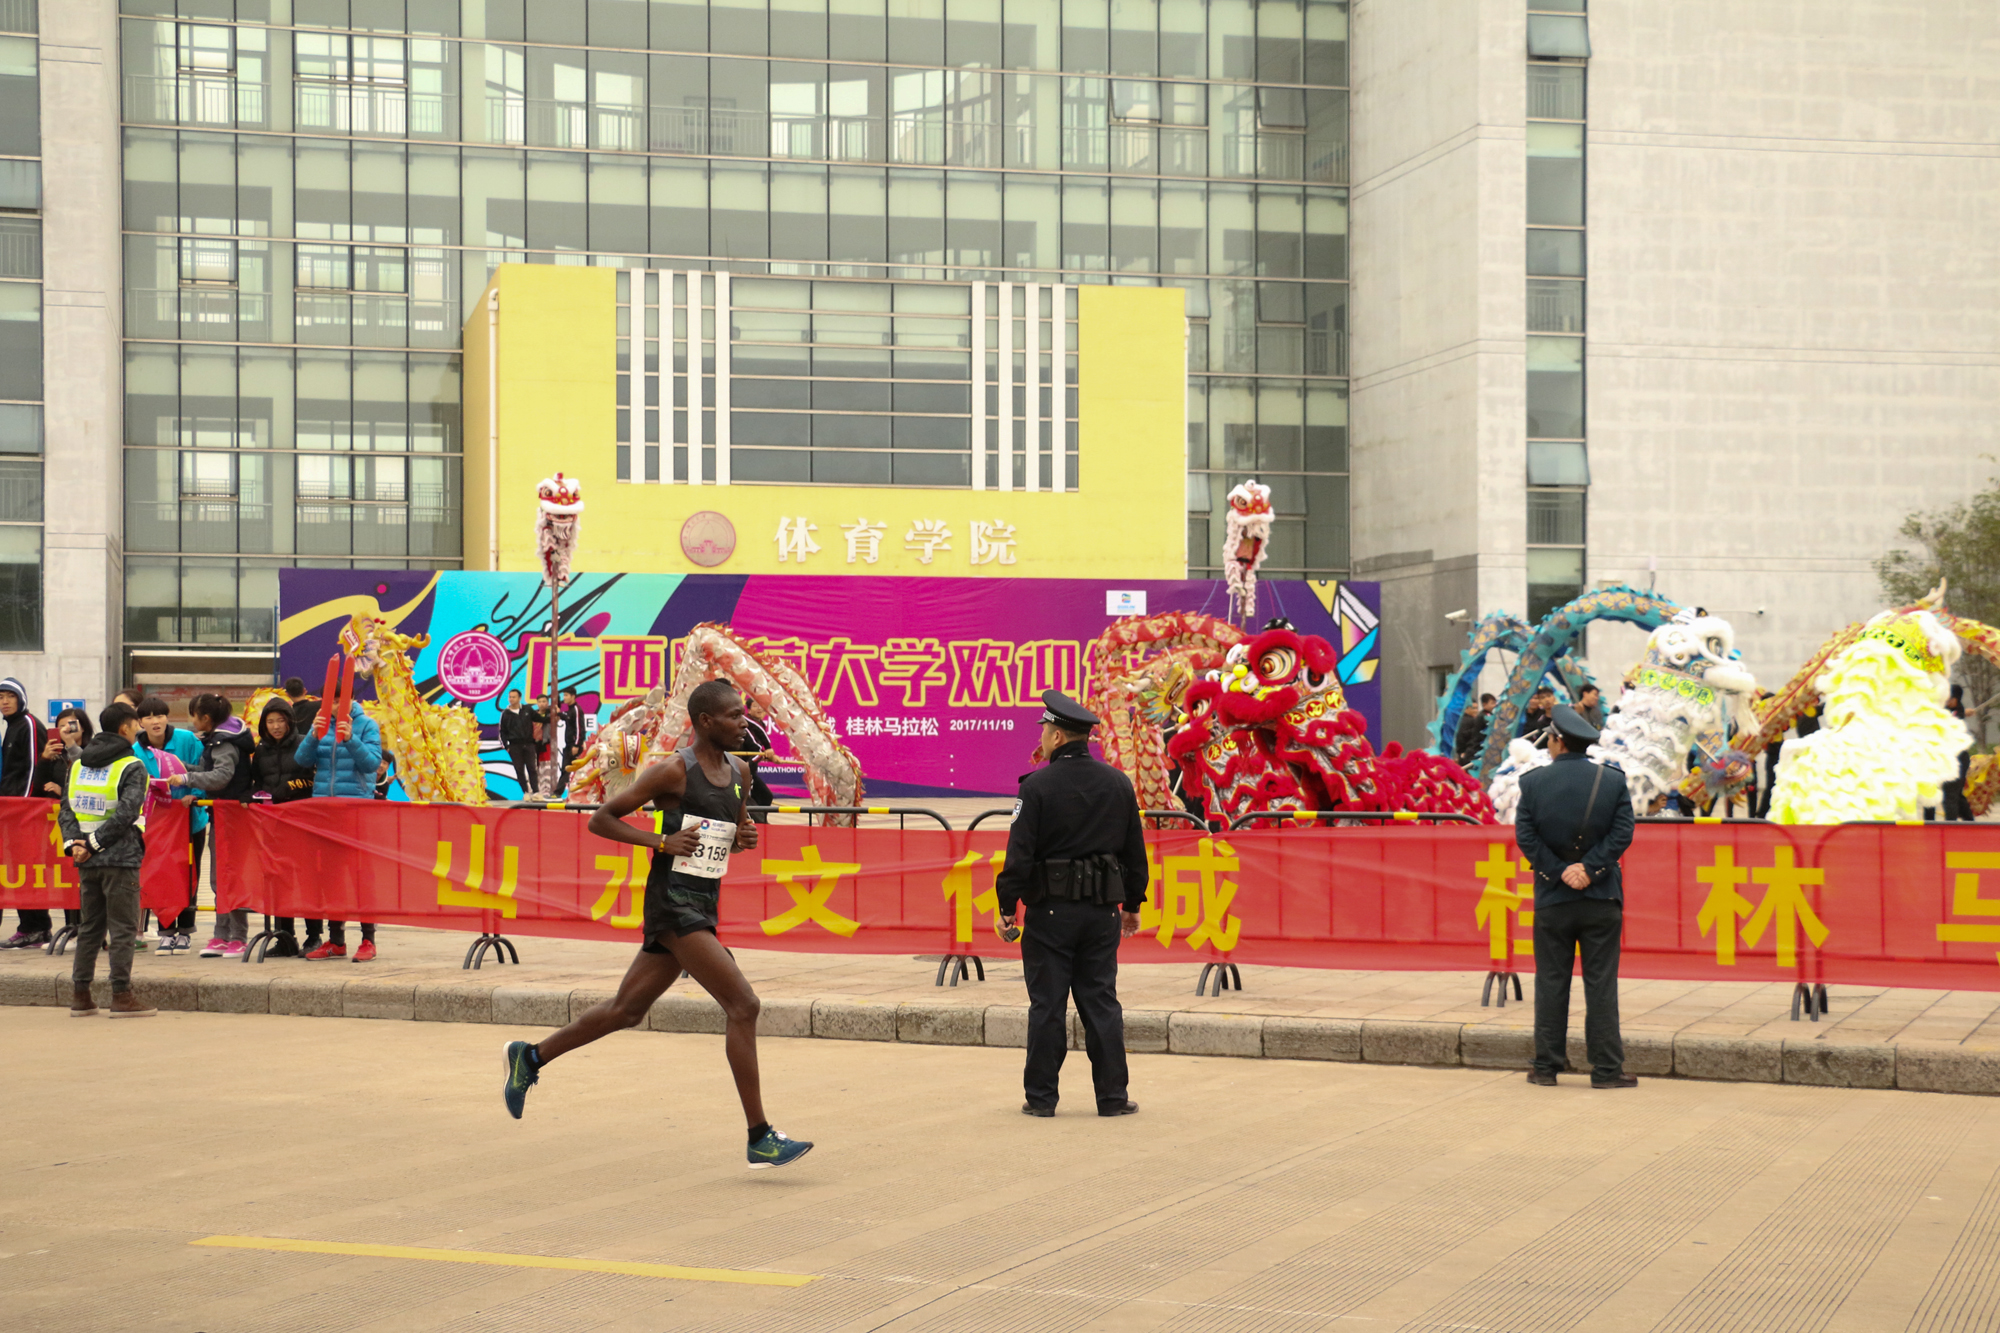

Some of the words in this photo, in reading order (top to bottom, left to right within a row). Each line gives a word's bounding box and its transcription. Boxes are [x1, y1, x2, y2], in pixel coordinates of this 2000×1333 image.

[773, 516, 1018, 565] 体育学院
[846, 716, 939, 736] 桂林马拉松
[950, 719, 1014, 731] 2017/11/19
[0, 864, 80, 888] UIL
